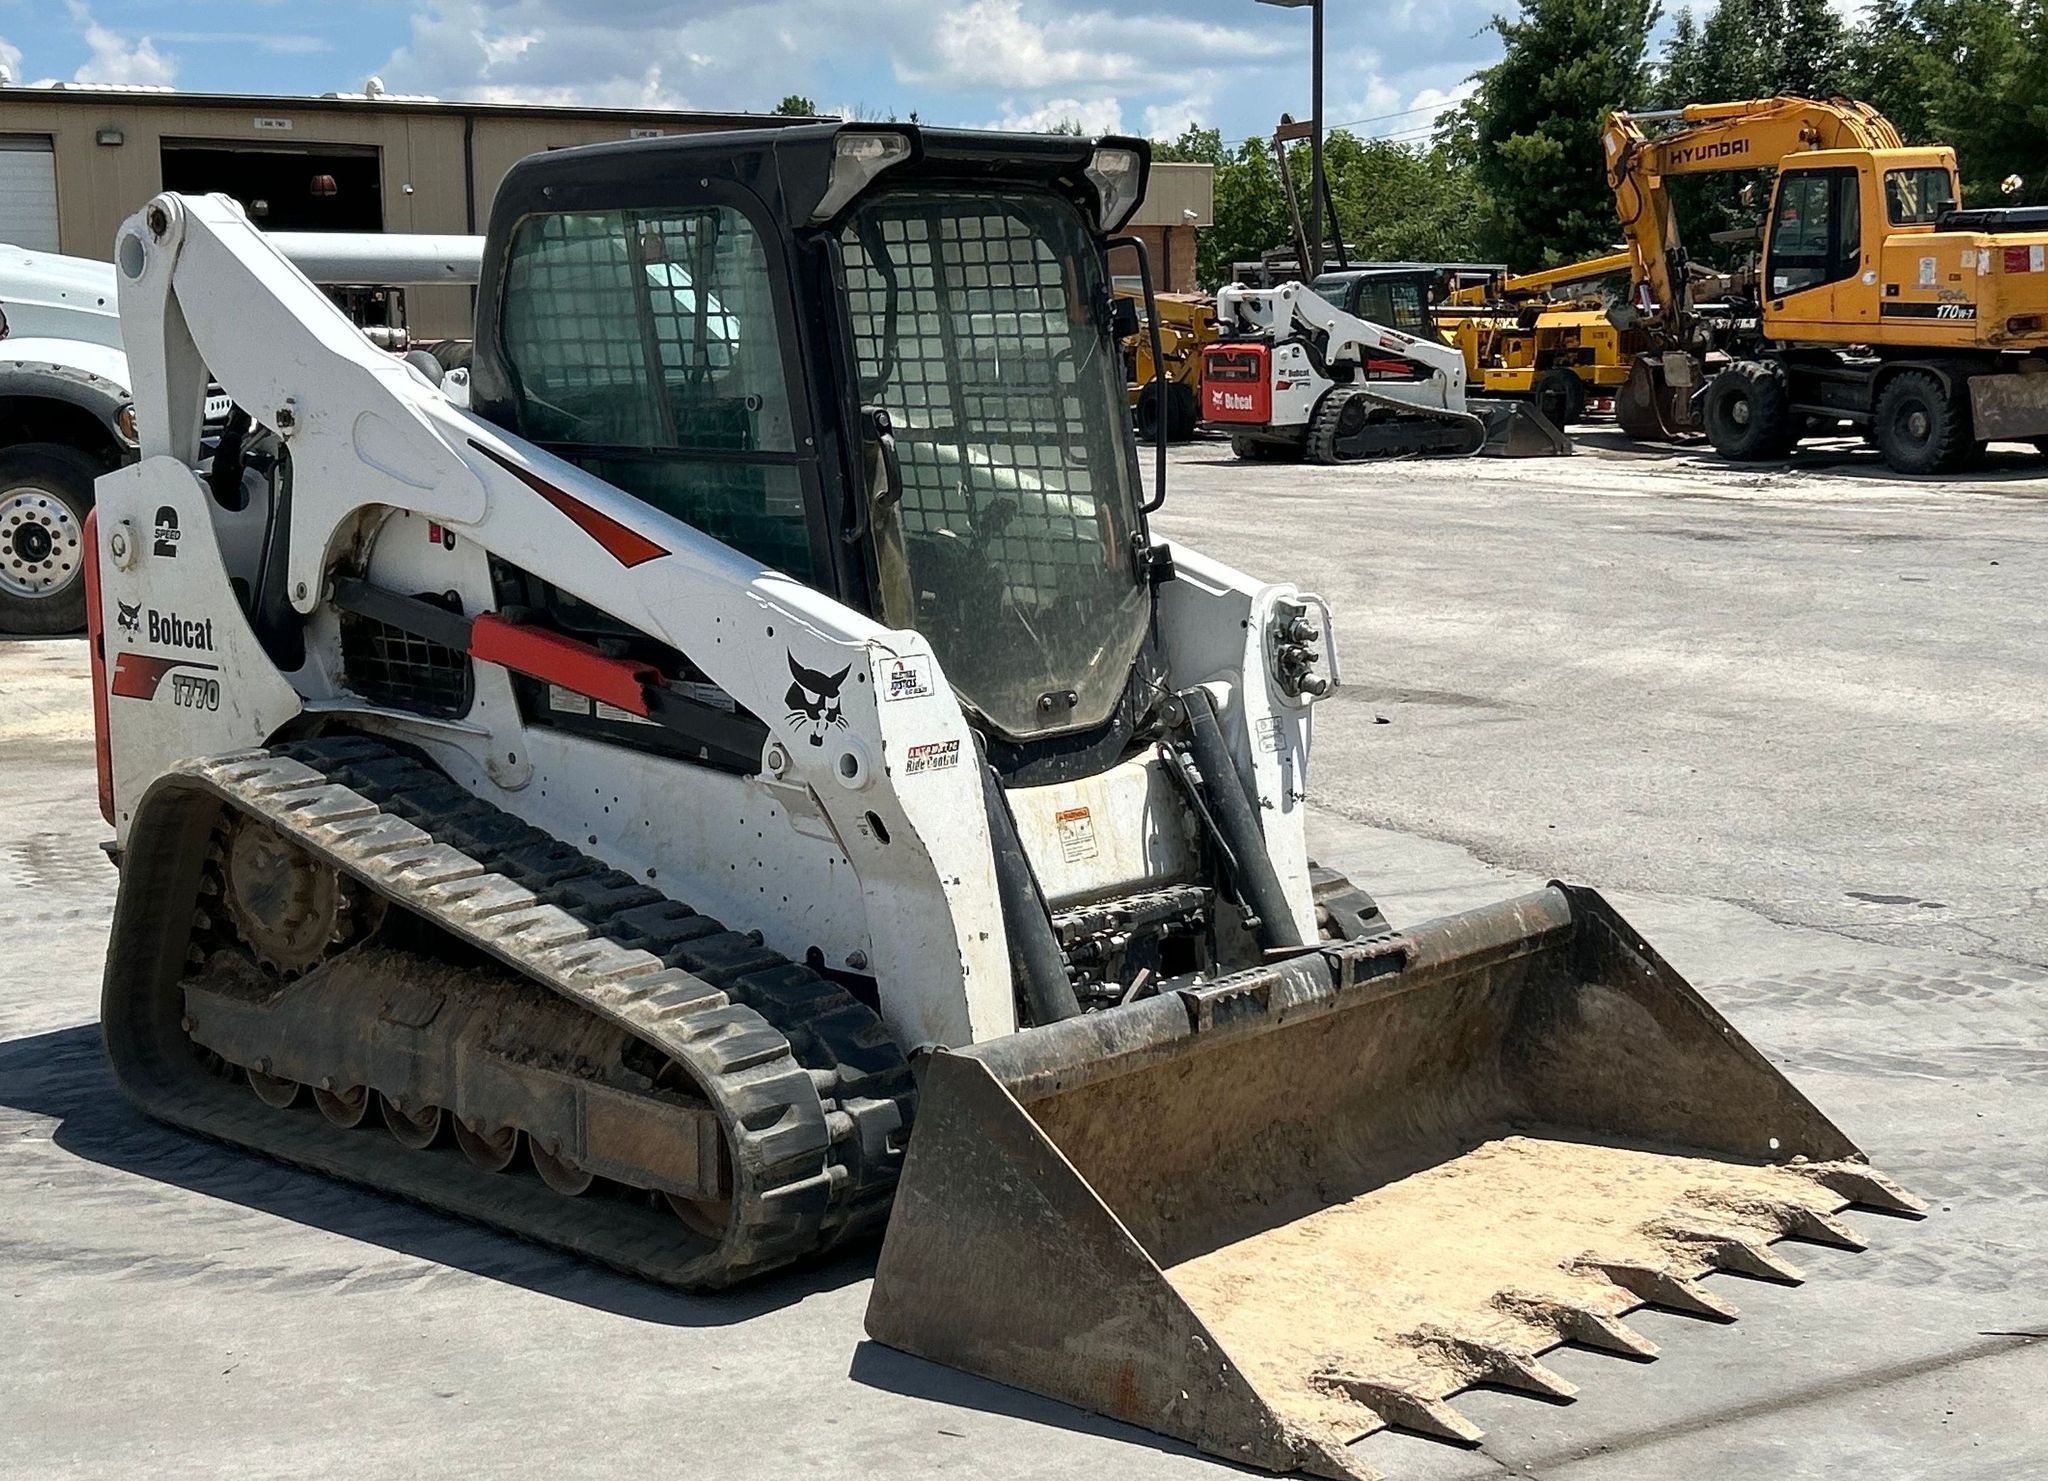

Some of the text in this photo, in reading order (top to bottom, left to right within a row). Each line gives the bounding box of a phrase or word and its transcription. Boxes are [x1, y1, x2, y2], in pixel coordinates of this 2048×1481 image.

[1671, 139, 1749, 165] HYUNDAI
[1224, 392, 1253, 410] Bobcat
[153, 528, 181, 541] SPEED
[147, 609, 214, 652] Bobcat
[172, 673, 220, 712] T770
[905, 758, 926, 773] Ride
